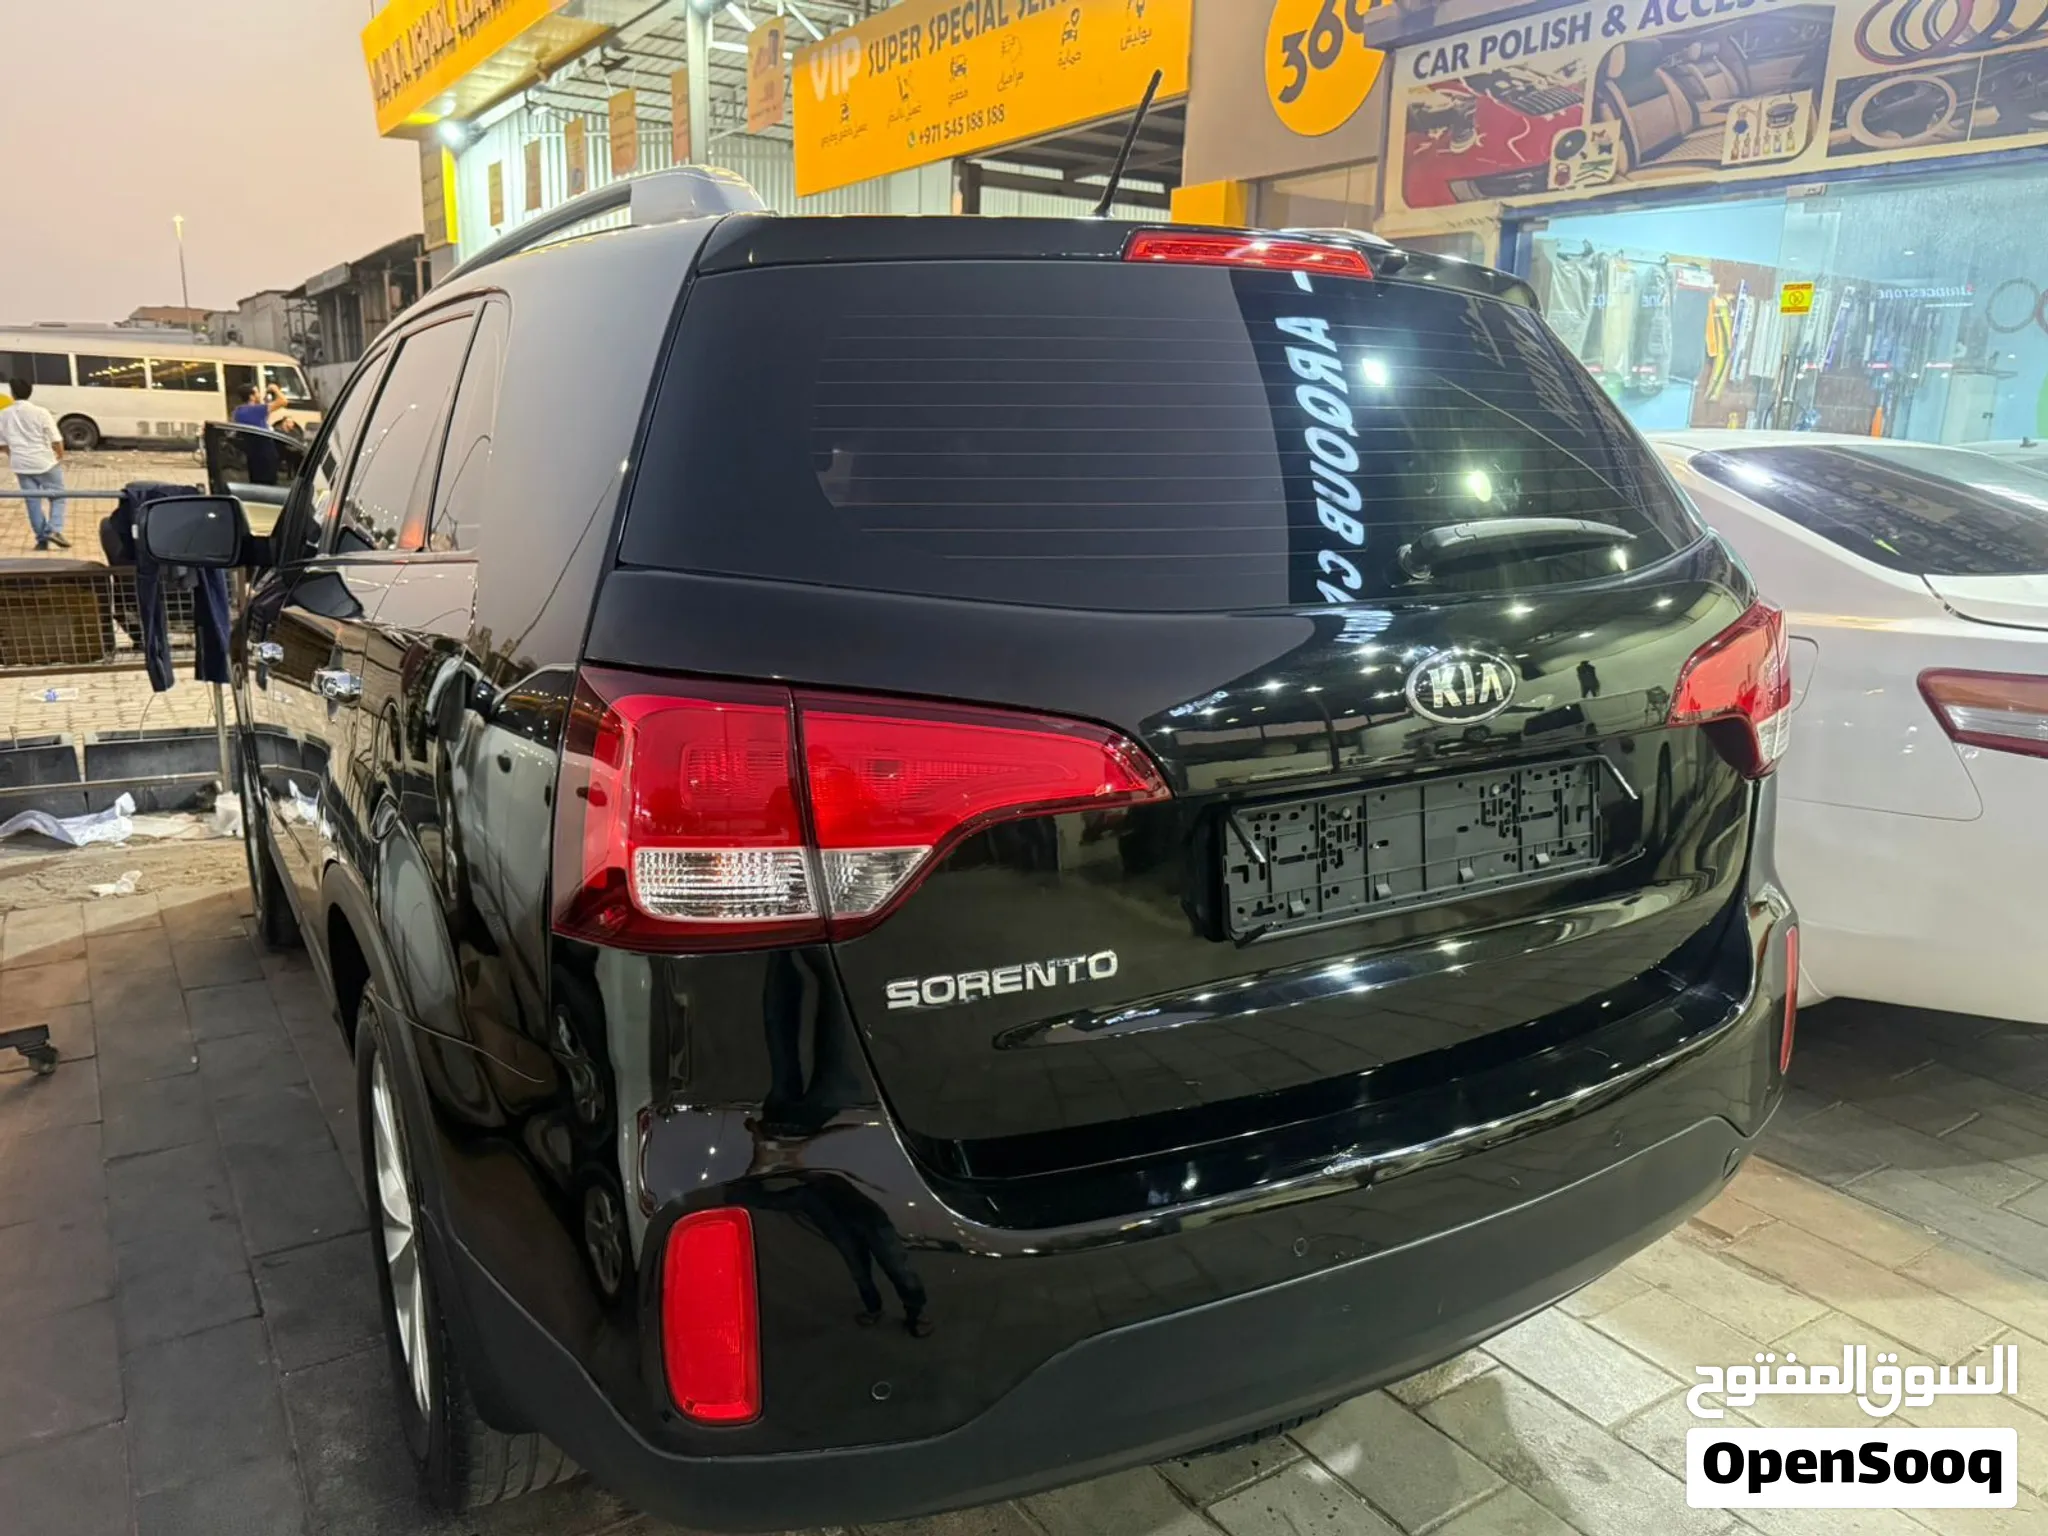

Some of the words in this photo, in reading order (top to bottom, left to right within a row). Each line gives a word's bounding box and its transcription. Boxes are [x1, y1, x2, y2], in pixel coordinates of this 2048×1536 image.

[810, 35, 861, 102] VIP
[868, 24, 922, 78] SUPER
[929, 0, 1009, 55] SPECIAL
[1413, 42, 1470, 80] CAR
[1479, 11, 1592, 66] POLISH
[1602, 4, 1627, 38] &
[919, 122, 941, 145] +971
[944, 115, 964, 140] 545
[966, 109, 984, 133] 188
[987, 102, 1005, 127] 188
[1427, 661, 1504, 709] KIA
[885, 949, 1119, 1010] SORENTO
